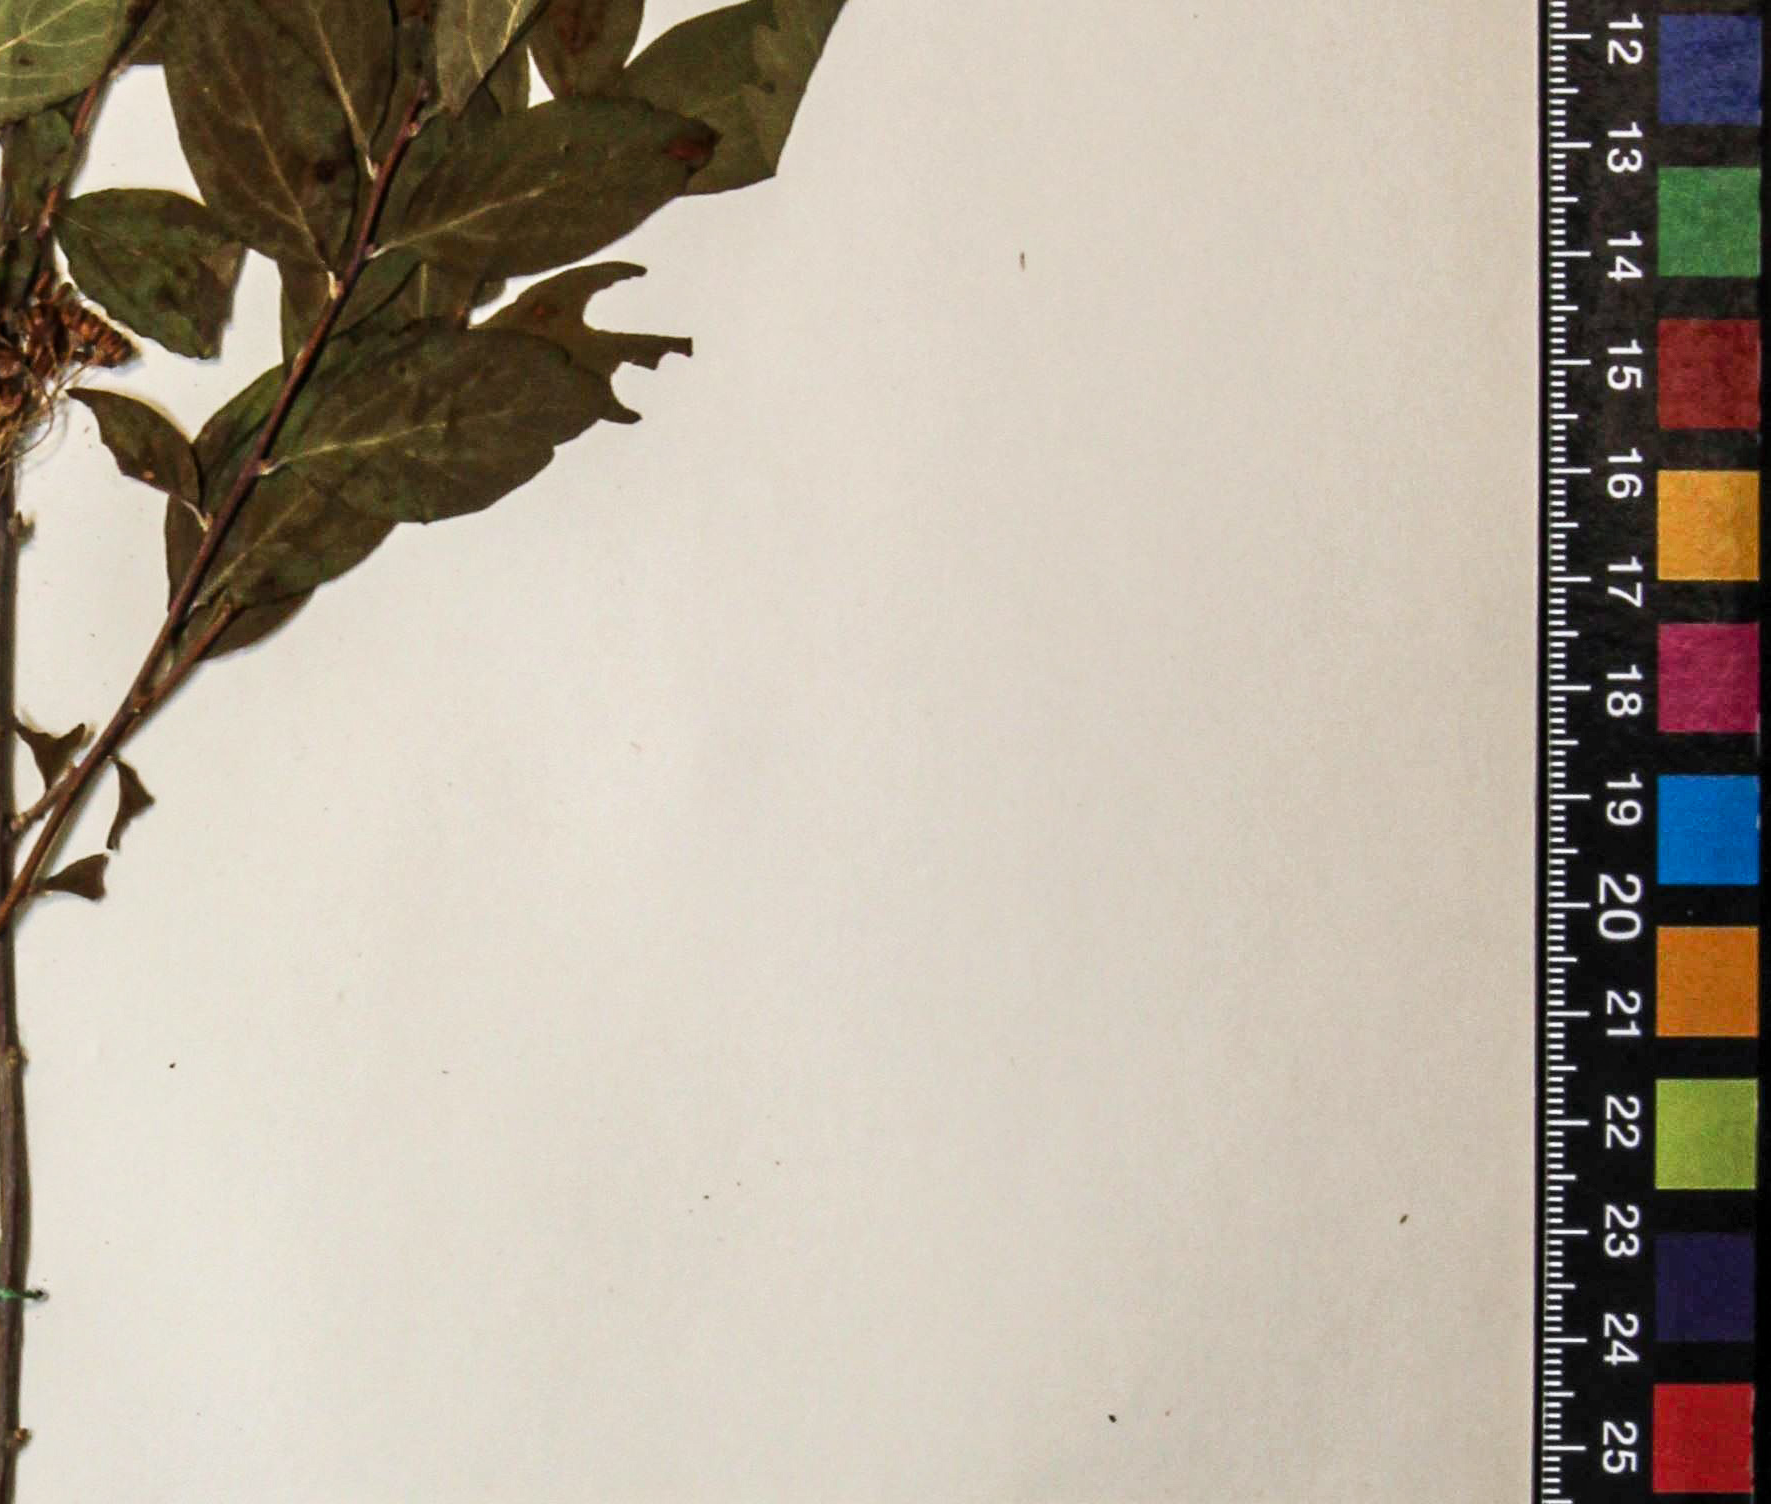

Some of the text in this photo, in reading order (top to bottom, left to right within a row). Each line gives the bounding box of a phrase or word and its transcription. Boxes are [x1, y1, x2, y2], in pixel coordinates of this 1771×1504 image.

[1607, 12, 1644, 65] 12
[1606, 121, 1643, 174] 13
[1606, 230, 1643, 282] 14
[1606, 339, 1644, 391] 15
[1606, 447, 1643, 499] 16
[1607, 556, 1644, 608] 17
[1606, 664, 1643, 718] 18
[1606, 772, 1643, 826] 19
[1598, 873, 1642, 941] 20
[1606, 990, 1641, 1036] 21
[1605, 1095, 1641, 1149] 22
[1604, 1204, 1640, 1258] 23
[1603, 1313, 1640, 1366] 24
[1602, 1421, 1638, 1474] 25
